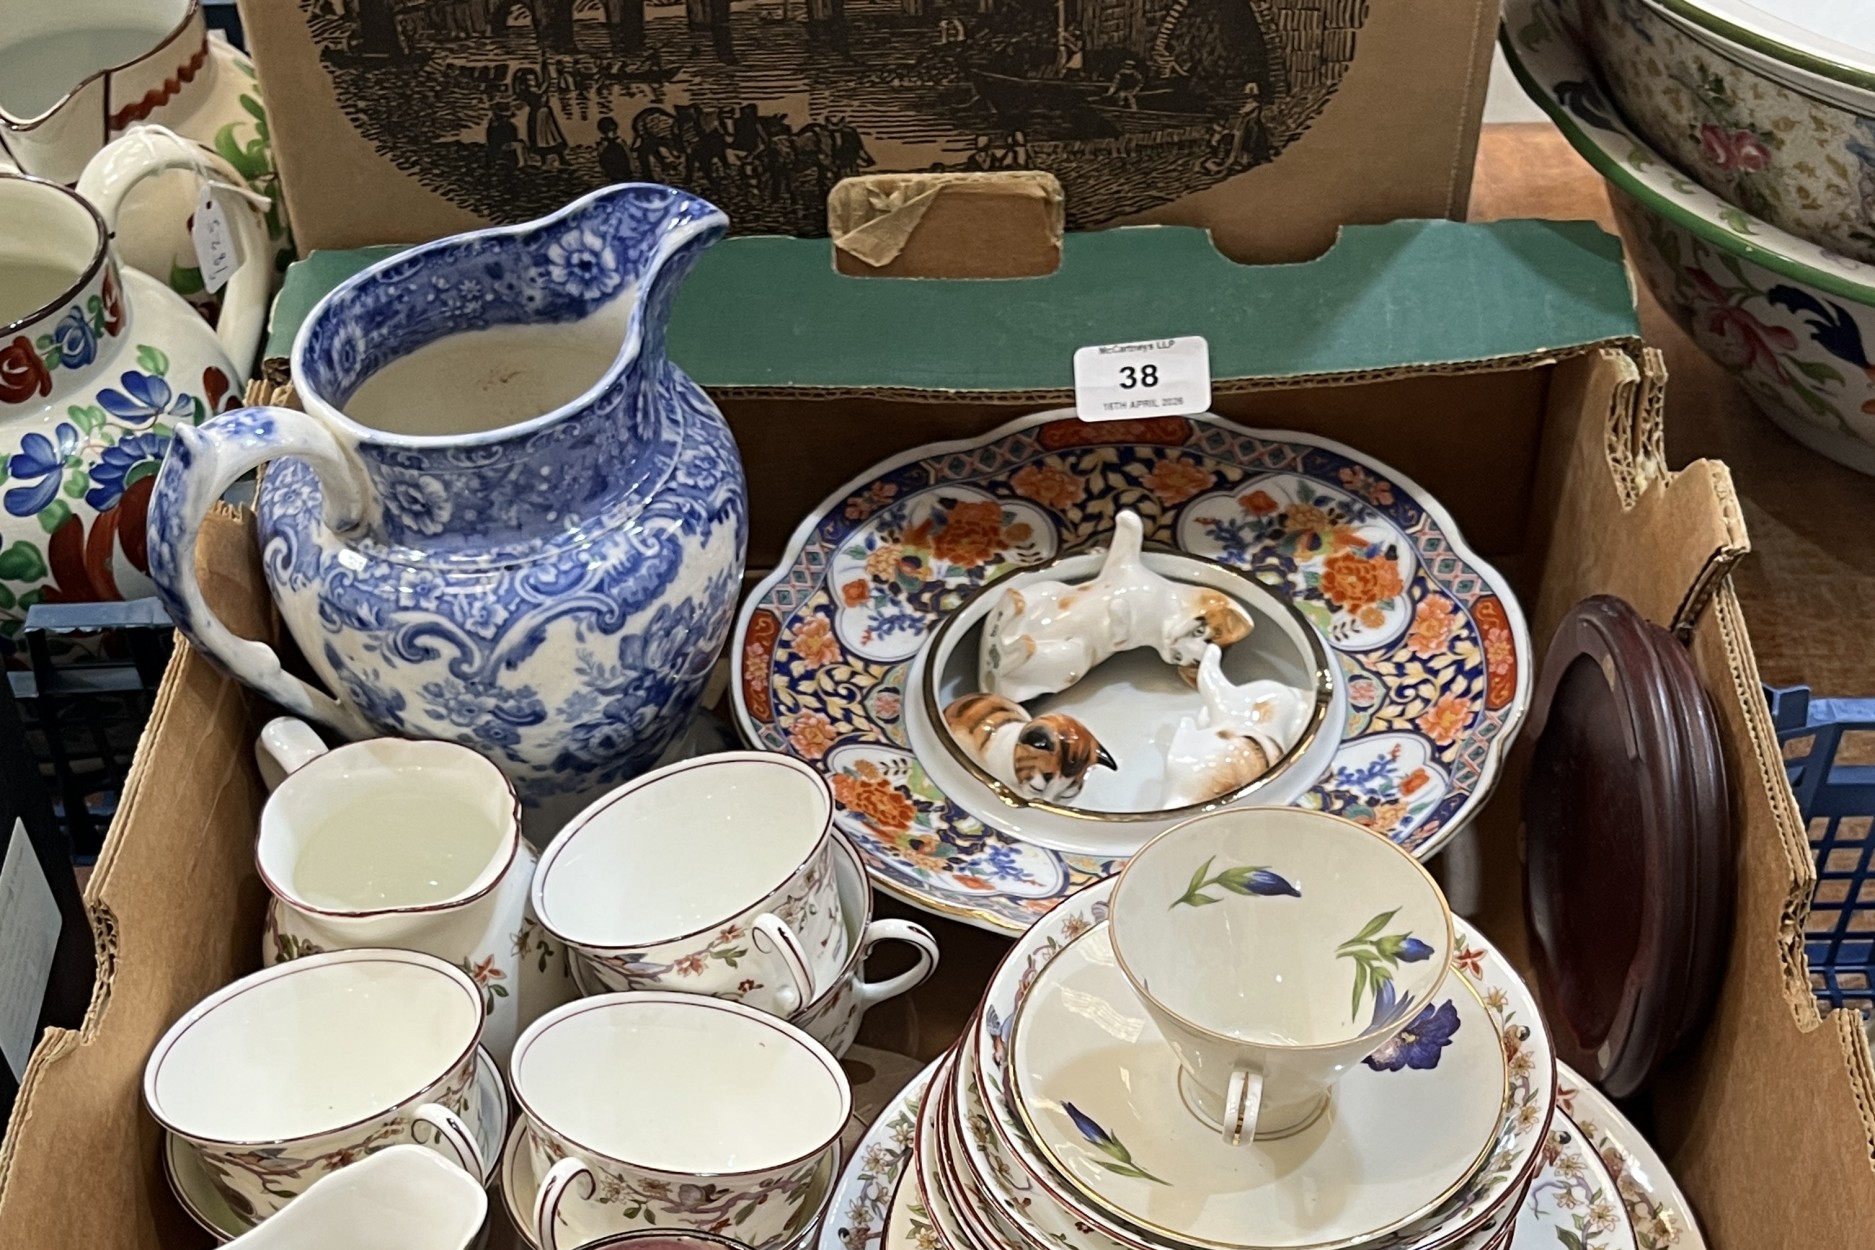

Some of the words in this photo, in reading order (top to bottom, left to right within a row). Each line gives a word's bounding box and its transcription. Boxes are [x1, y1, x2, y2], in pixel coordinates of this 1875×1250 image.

[1099, 344, 1154, 354] McCartneys
[1156, 340, 1175, 349] LLP
[1119, 364, 1158, 389] 38
[1129, 399, 1160, 408] APRIL
